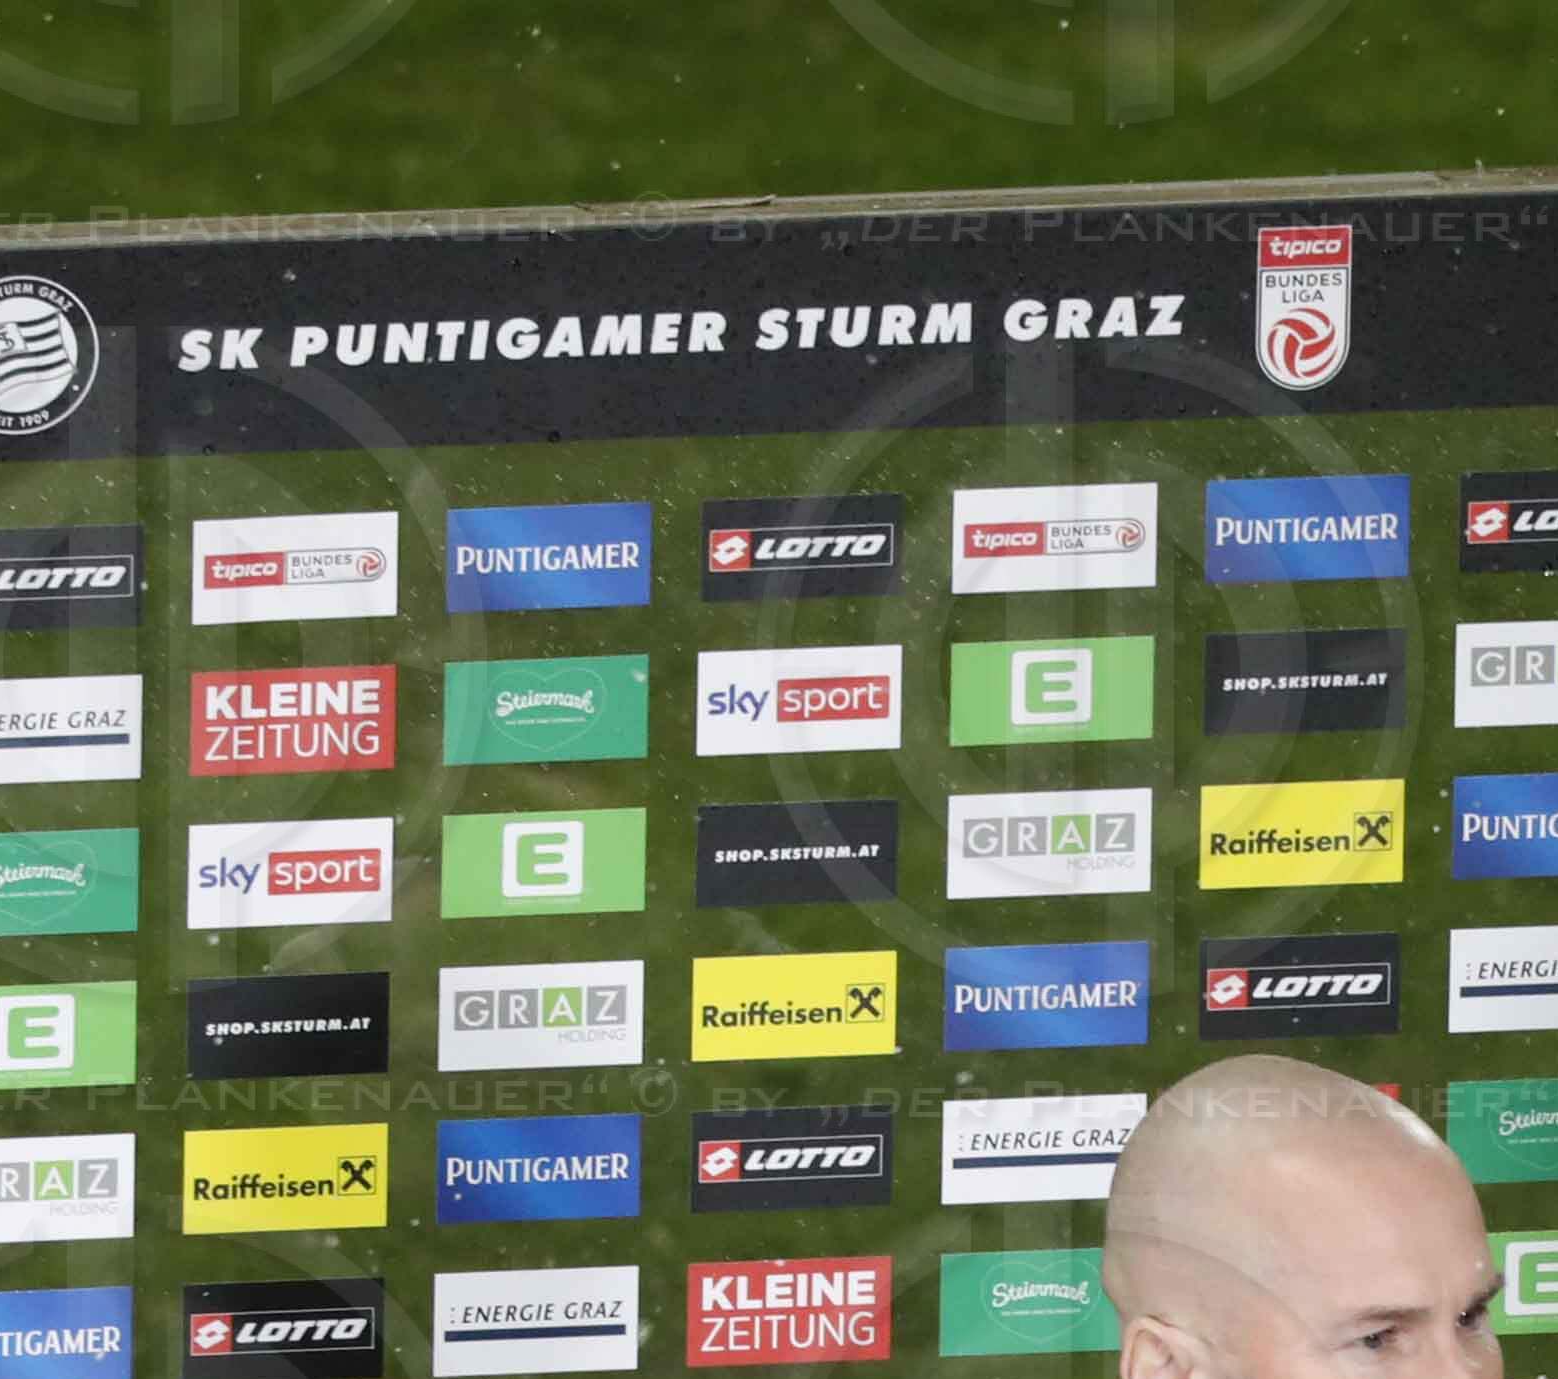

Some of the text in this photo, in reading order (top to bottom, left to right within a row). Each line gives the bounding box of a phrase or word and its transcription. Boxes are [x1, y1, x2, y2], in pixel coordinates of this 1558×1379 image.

[1269, 236, 1342, 259] tipico
[1265, 272, 1343, 289] BUNDES
[38, 285, 74, 311] GRAZ
[1282, 289, 1325, 304] LIGA
[178, 295, 1185, 372] SK PUNTIGAMER STURM GRAZ
[971, 529, 1038, 551] tipico
[1050, 524, 1112, 538] BUNDES
[1215, 513, 1398, 546] PUNTIGAMER
[754, 533, 887, 560] LOTTO
[1050, 538, 1085, 550] LIGA
[211, 559, 278, 581] tipico
[290, 554, 352, 568] BUNDES
[456, 542, 639, 575] PUNTIGAMER
[290, 568, 325, 580] LIGA
[1222, 672, 1388, 691] SHOP.SKSTURM.AT
[205, 679, 381, 720] KLEINE
[495, 689, 595, 717] Steiermark
[707, 682, 883, 722] sky sport
[67, 709, 127, 730] GRAZ
[204, 720, 380, 761] ZEITUNG
[968, 818, 1128, 854] GRAZ
[1210, 828, 1350, 856] Raiffeisen
[714, 844, 880, 863] SHOP.SKSTURM.AT
[198, 855, 374, 895] sky sport
[954, 980, 1137, 1013] PUNTIGAMER
[1251, 972, 1384, 999] LOTTO
[459, 990, 619, 1026] GRAZ
[702, 1000, 842, 1028] Raiffeisen
[205, 1017, 371, 1036] SHOP.SKSTURM.AT
[446, 1153, 629, 1186] PUNTIGAMER
[194, 1173, 334, 1201] Raiffeisen
[701, 1270, 877, 1311] KLEINE
[990, 1280, 1090, 1308] Steiermark
[462, 1300, 624, 1325] ENERGIE GRAZ
[235, 1317, 368, 1344] LOTTO
[700, 1311, 876, 1352] ZEITUNG
